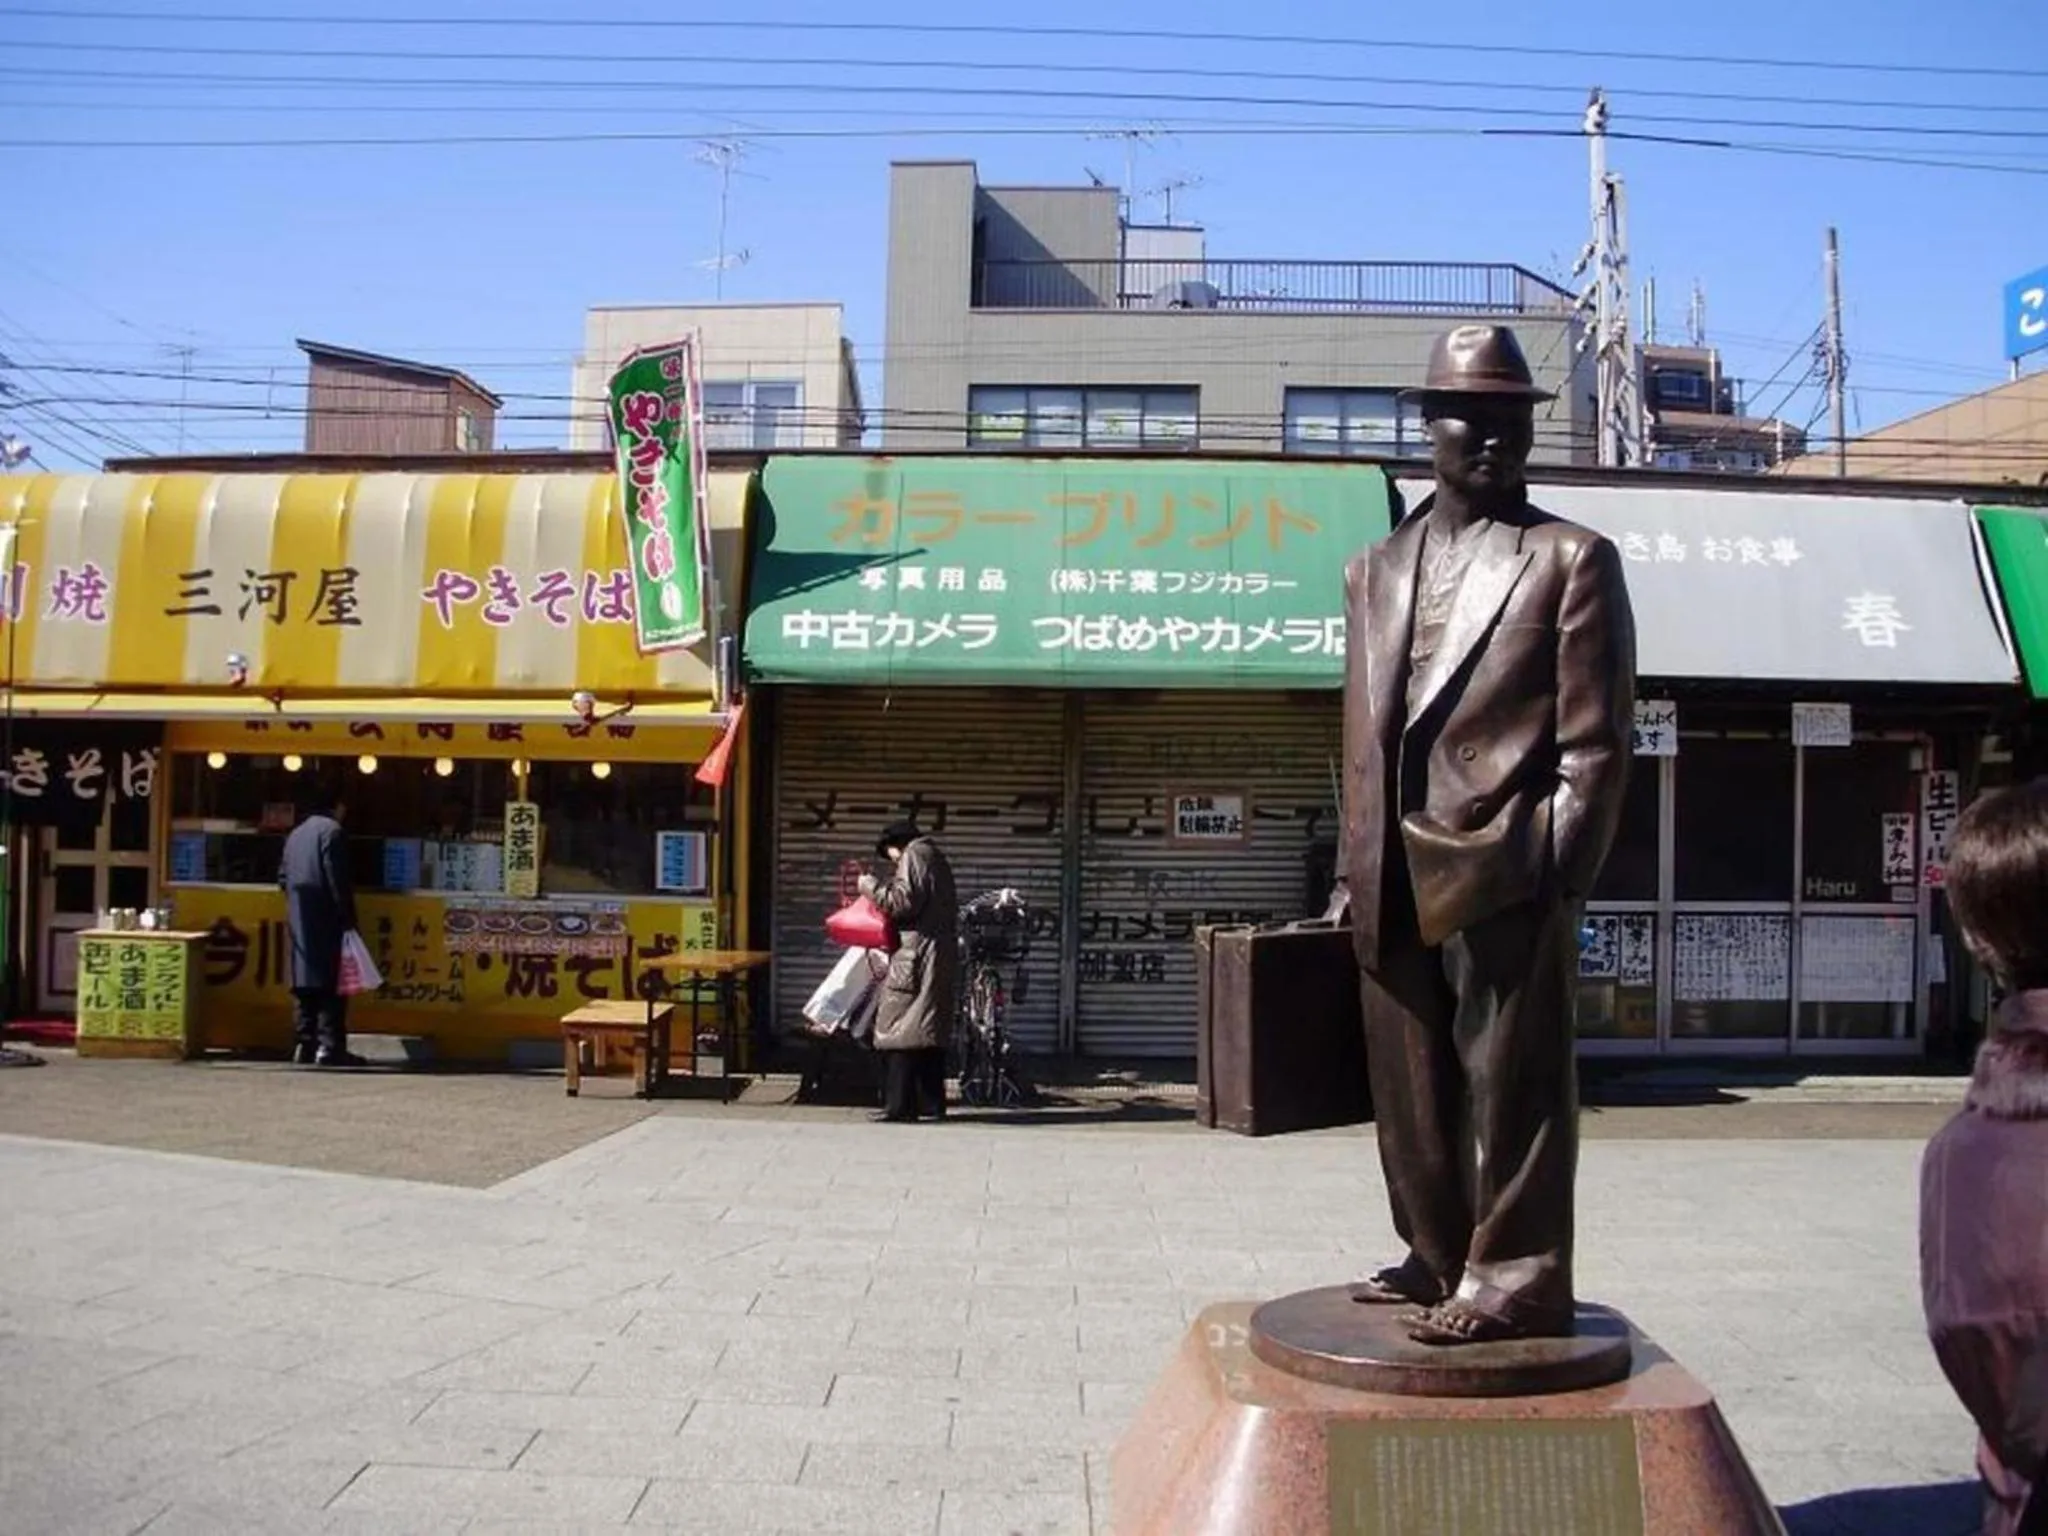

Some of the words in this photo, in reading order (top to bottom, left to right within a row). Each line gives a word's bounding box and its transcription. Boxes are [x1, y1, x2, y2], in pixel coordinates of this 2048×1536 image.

[620, 391, 675, 583] やきそば
[1613, 536, 1688, 564] き鳥
[1702, 536, 1804, 567] お食事
[163, 567, 363, 627] 三河屋
[422, 568, 633, 626] やきそば
[859, 566, 1007, 592] 写真用品
[782, 609, 998, 651] 中古カメラ
[1842, 591, 1913, 648] 春
[0, 747, 162, 799] きそば
[508, 805, 536, 871] あま酒
[1806, 877, 1856, 898] Haru
[118, 943, 147, 1010] あま酒
